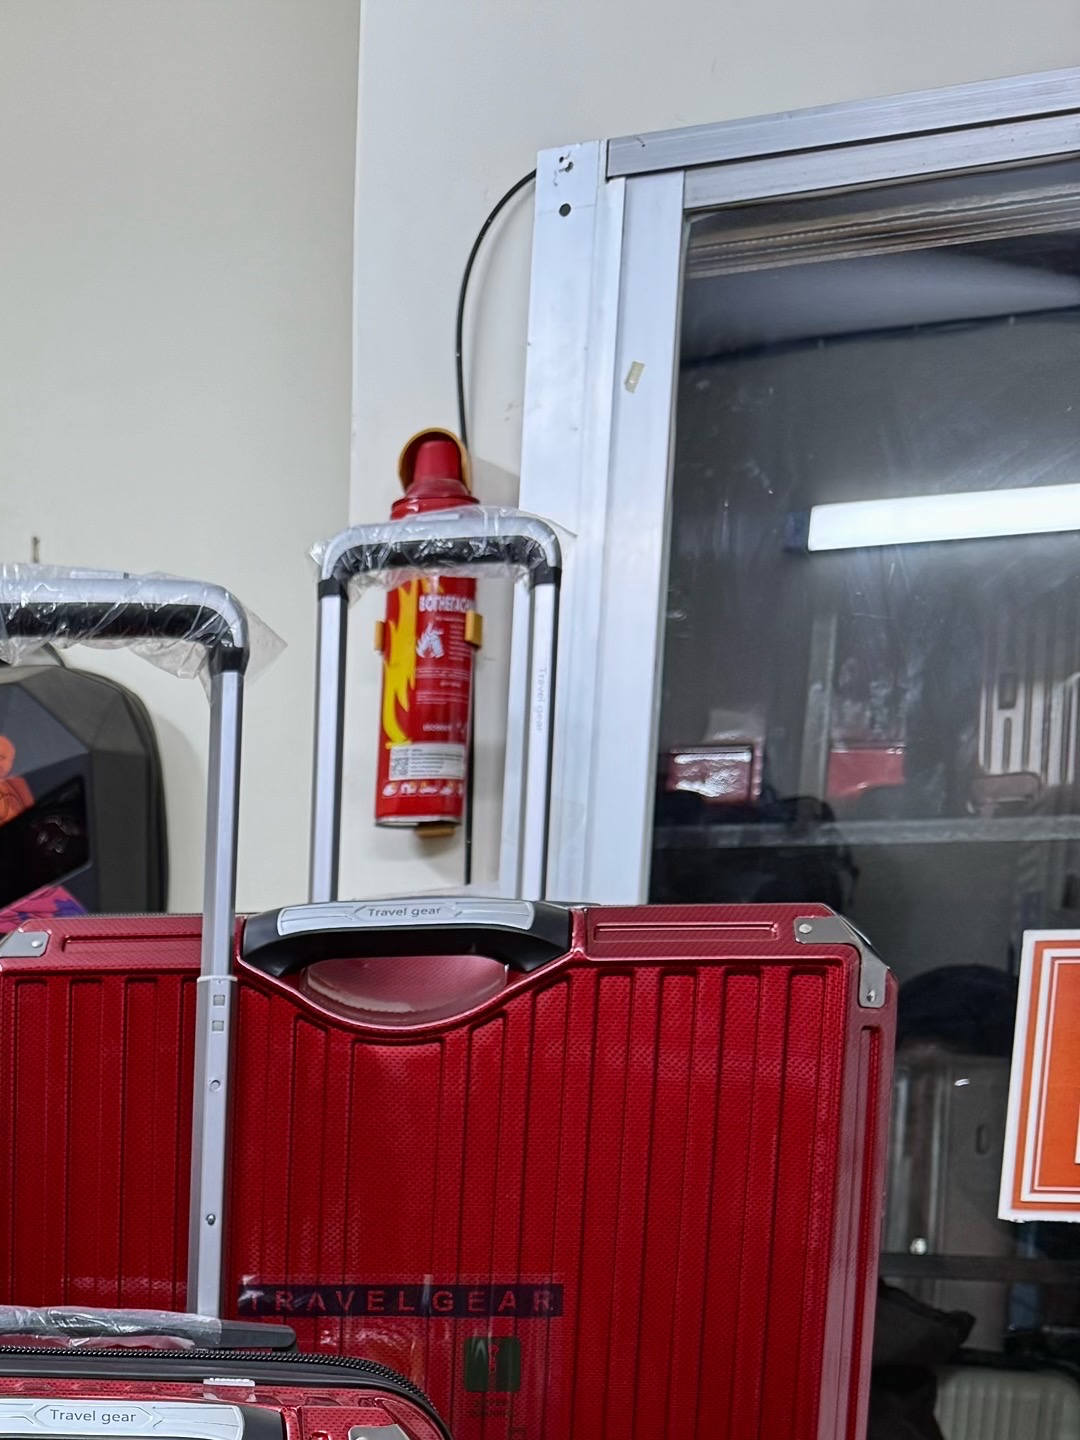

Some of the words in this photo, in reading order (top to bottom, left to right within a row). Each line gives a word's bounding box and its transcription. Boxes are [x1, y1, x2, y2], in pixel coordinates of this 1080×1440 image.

[536, 666, 547, 702] Travel
[534, 705, 544, 731] gear
[368, 907, 407, 917] Travel
[411, 907, 442, 918] gear
[50, 1409, 96, 1422] Travel
[101, 1412, 137, 1425] gear
